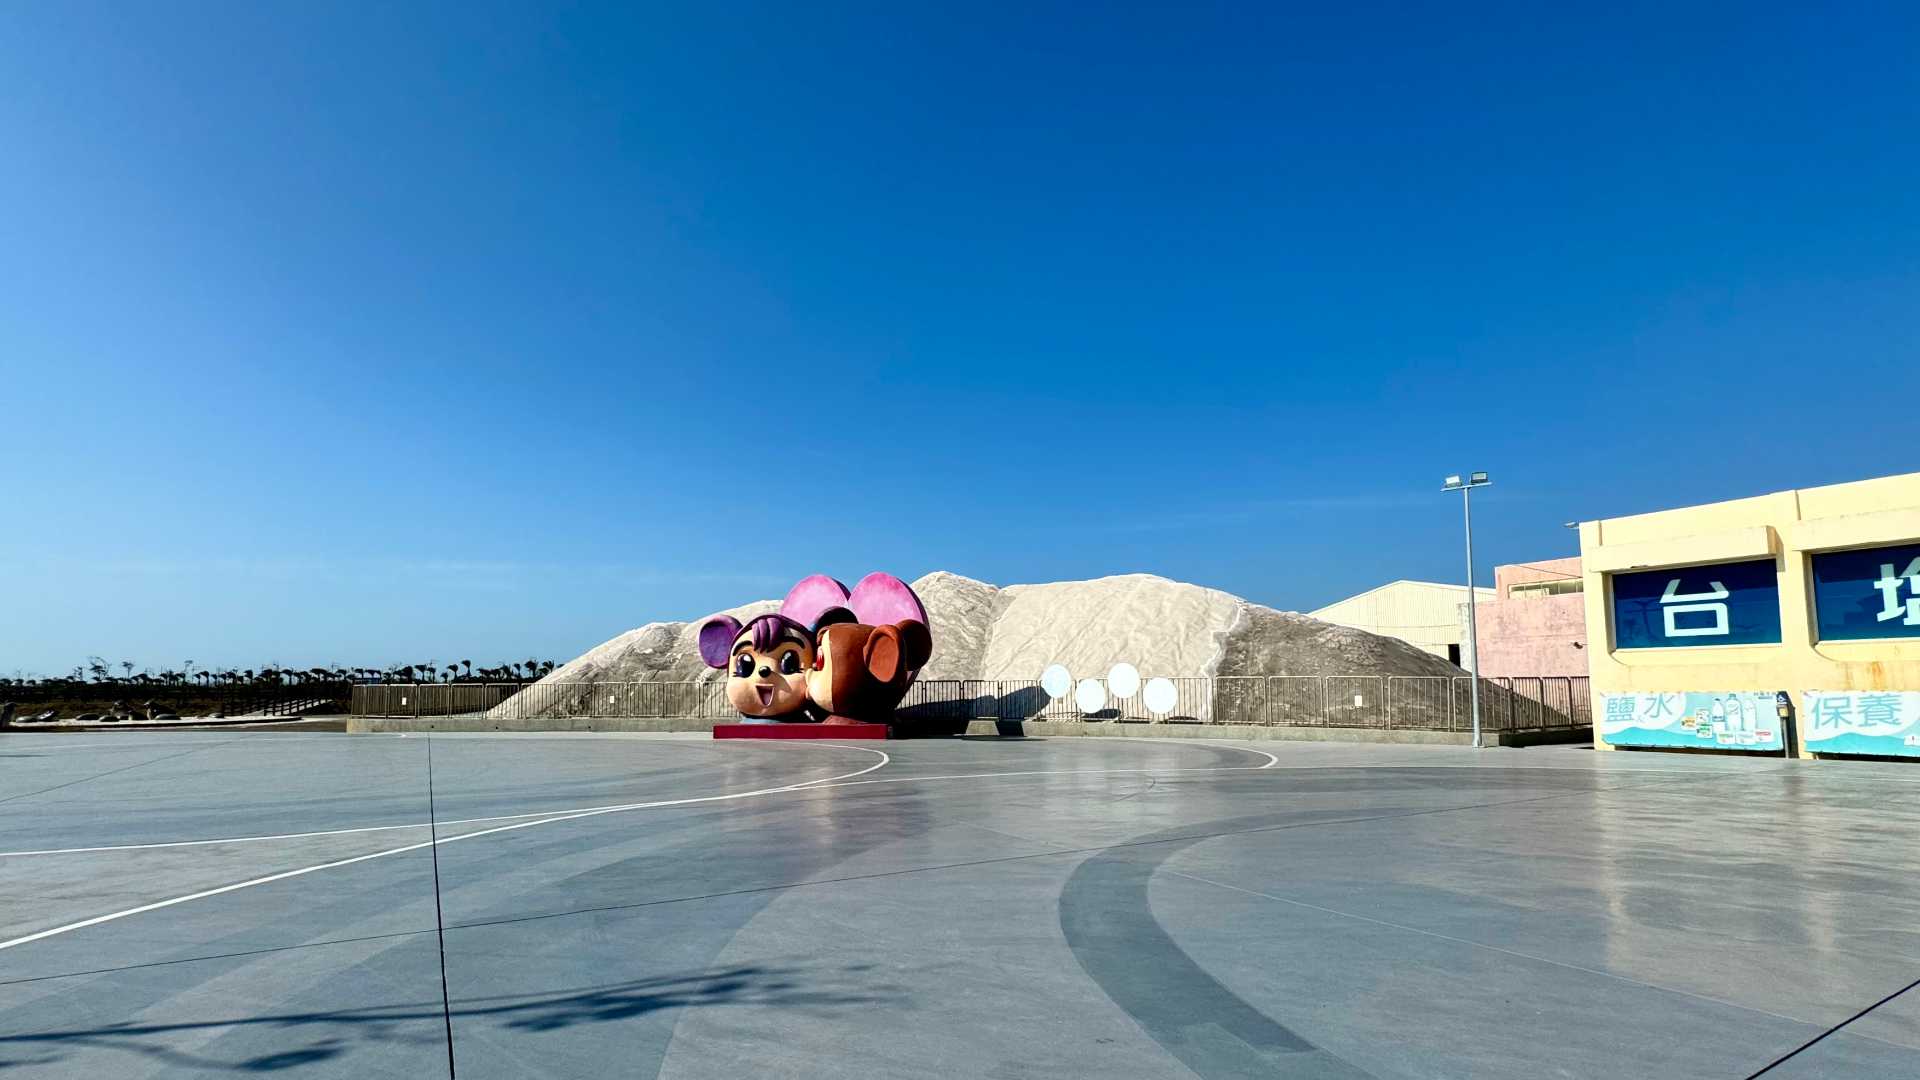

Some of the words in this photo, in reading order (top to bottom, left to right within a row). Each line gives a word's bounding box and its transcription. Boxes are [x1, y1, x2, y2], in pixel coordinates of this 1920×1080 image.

[1659, 579, 1729, 637] 台
[1606, 693, 1675, 722] 鹽水
[1811, 693, 1902, 729] 保養
